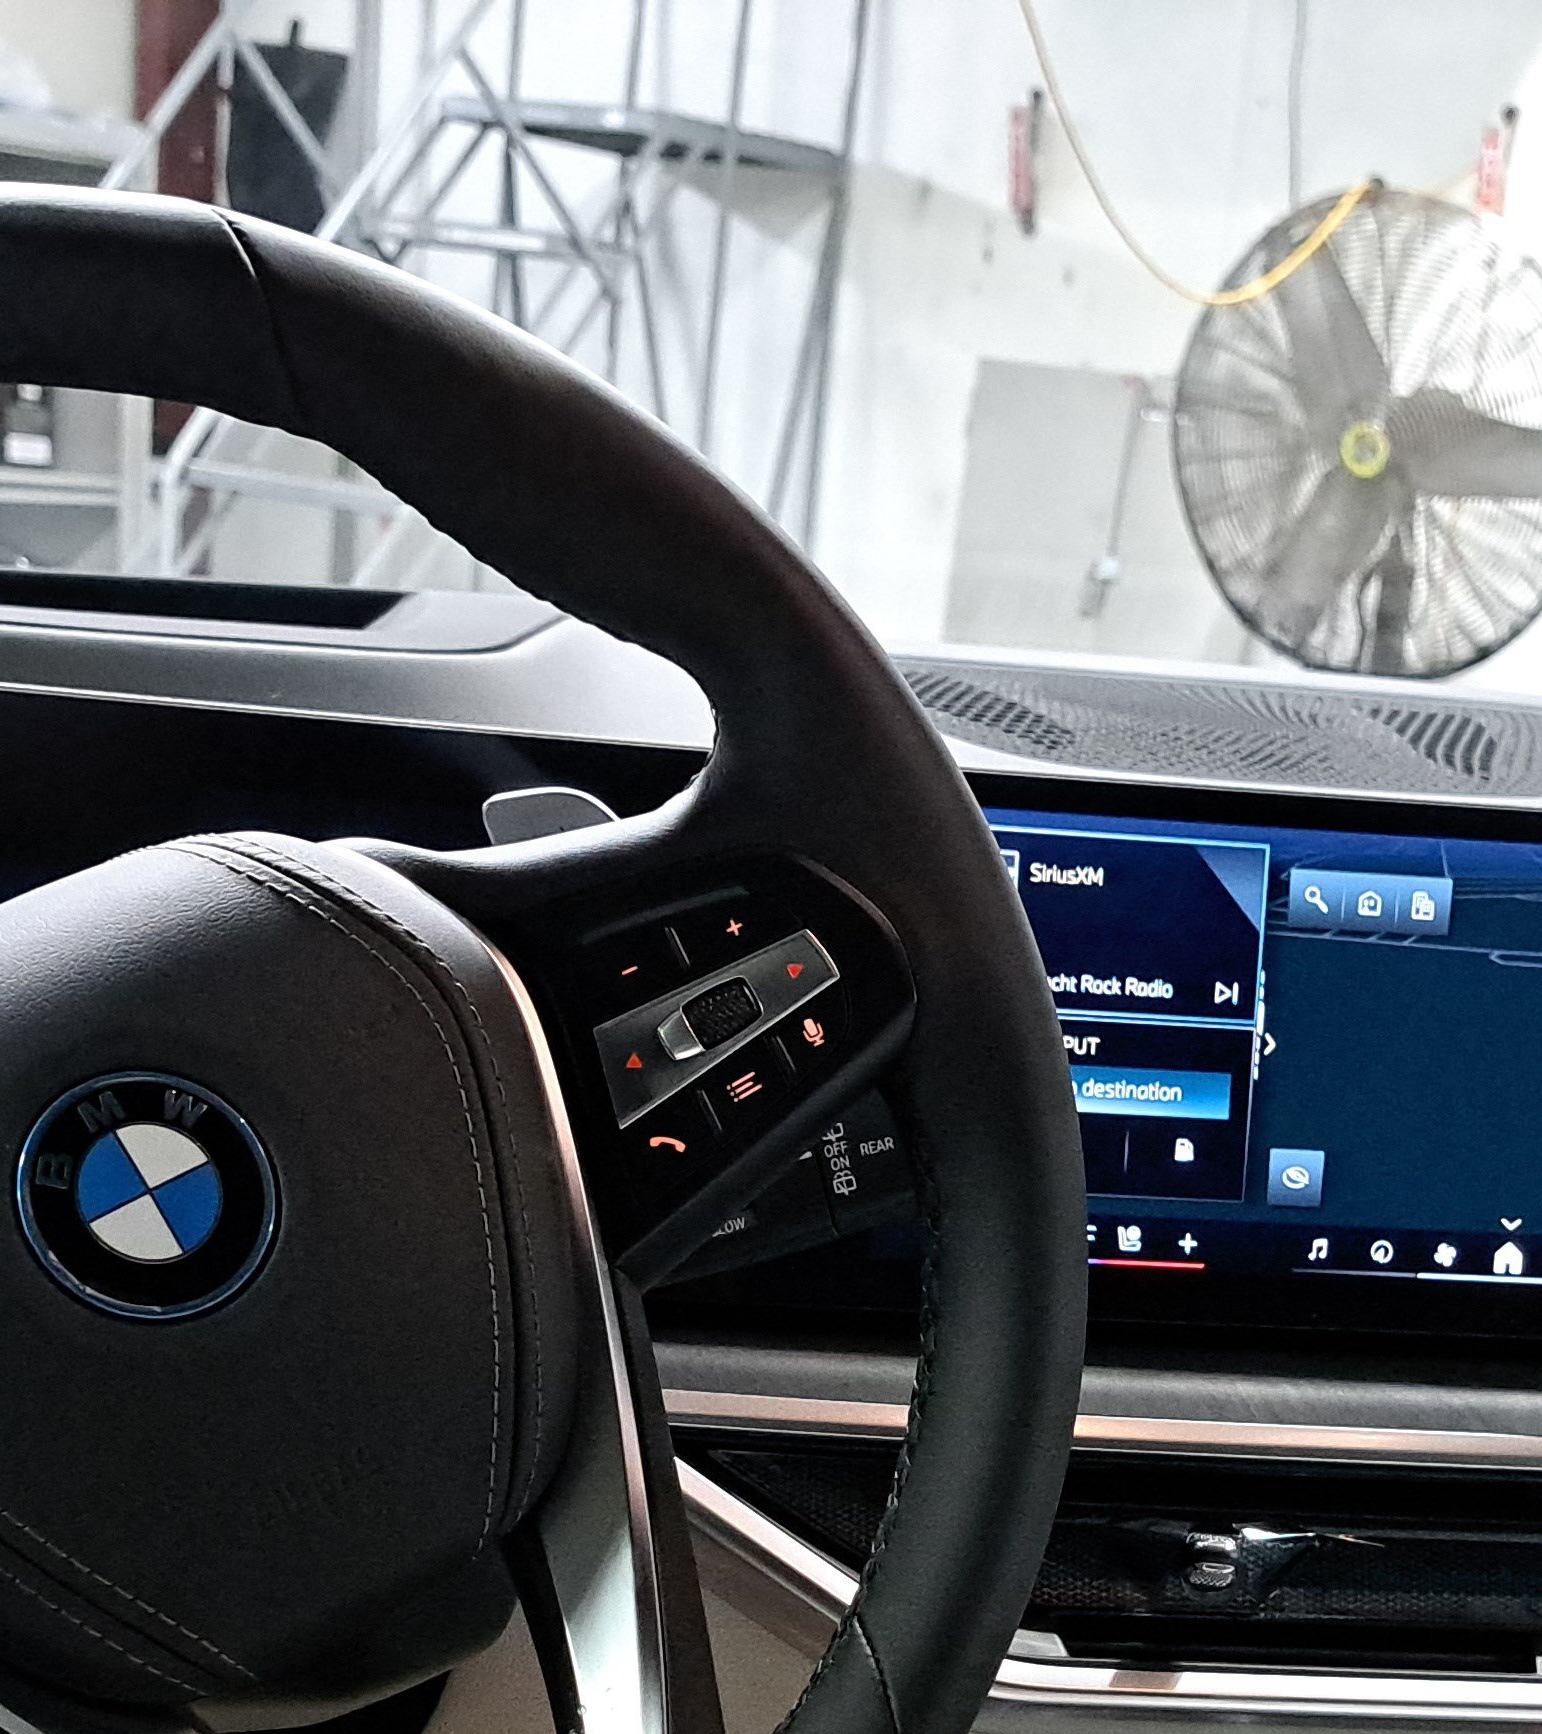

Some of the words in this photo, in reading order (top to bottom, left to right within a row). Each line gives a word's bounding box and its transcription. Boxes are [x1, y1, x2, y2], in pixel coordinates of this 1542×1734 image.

[1029, 862, 1105, 887] SiriusXM
[1080, 974, 1122, 995] Rock
[1125, 977, 1174, 999] Radio
[1082, 1078, 1183, 1102] destination
[824, 1141, 848, 1158] OFF
[859, 1137, 895, 1157] REAR
[830, 1156, 850, 1171] ON
